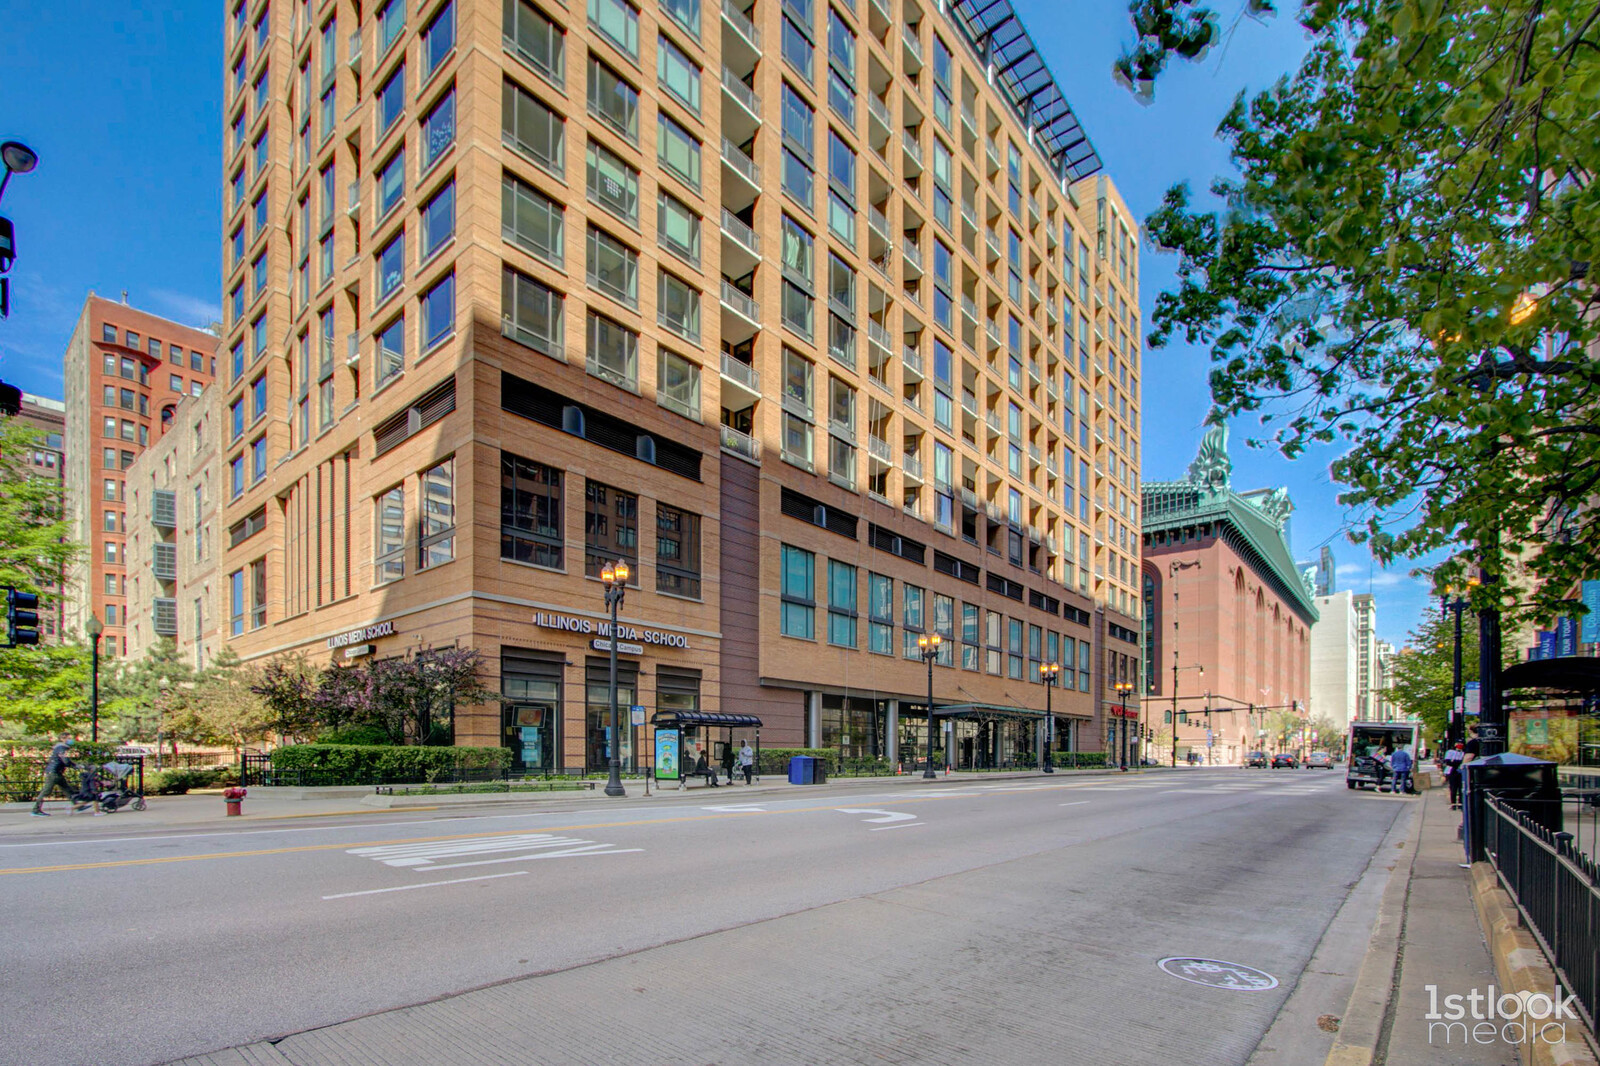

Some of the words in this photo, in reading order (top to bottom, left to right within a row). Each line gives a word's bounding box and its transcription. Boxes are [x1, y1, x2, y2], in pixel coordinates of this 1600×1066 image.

[349, 629, 367, 645] MEDIA
[367, 621, 393, 640] SCHOOL
[536, 612, 591, 634] ILLINOIS
[597, 622, 638, 641] MDIA
[643, 630, 691, 649] SCHOOL
[595, 640, 618, 651] Chica
[619, 643, 642, 653] Campus
[1542, 638, 1550, 658] PAUL
[1563, 638, 1571, 655] TOUR
